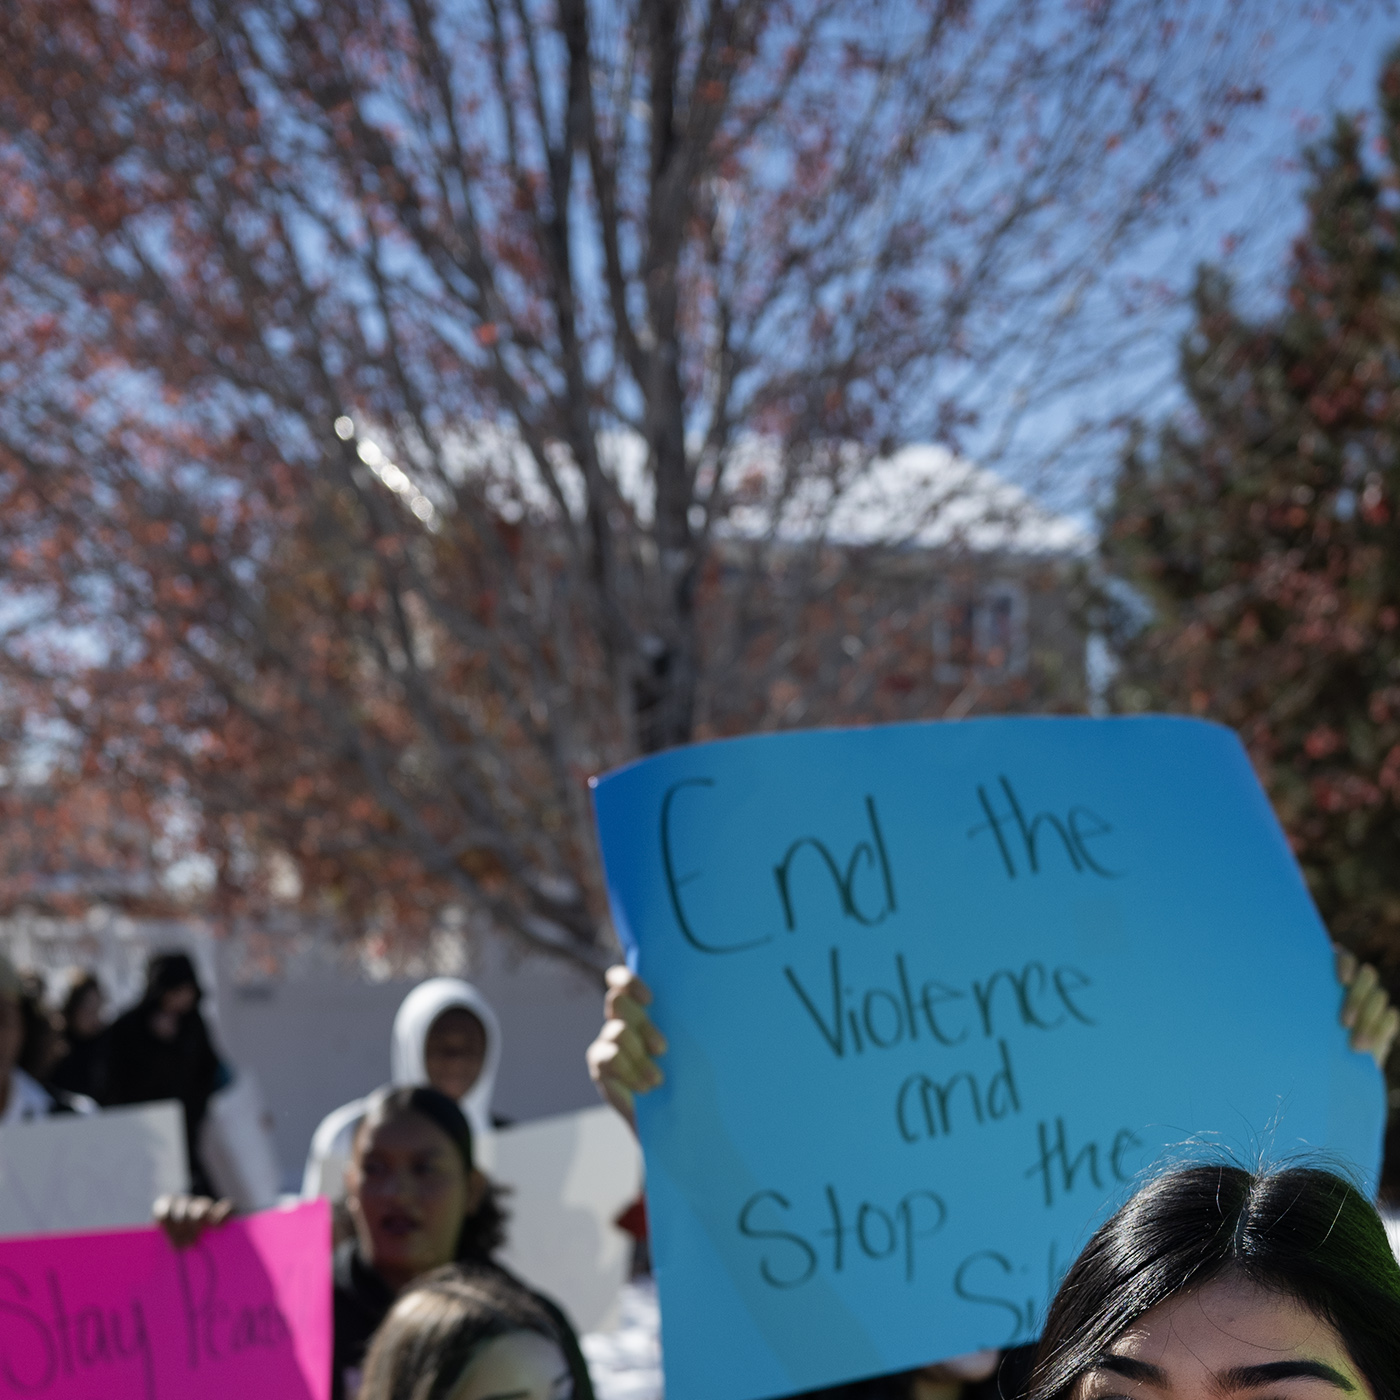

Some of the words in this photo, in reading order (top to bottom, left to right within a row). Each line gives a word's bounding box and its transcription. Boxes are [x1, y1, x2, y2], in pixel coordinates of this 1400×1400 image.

[659, 776, 900, 955] End
[966, 774, 1129, 881] the
[782, 945, 1100, 1060] Violence
[895, 1038, 1021, 1144] and
[737, 1183, 947, 1290] Stop
[1024, 1115, 1145, 1207] the
